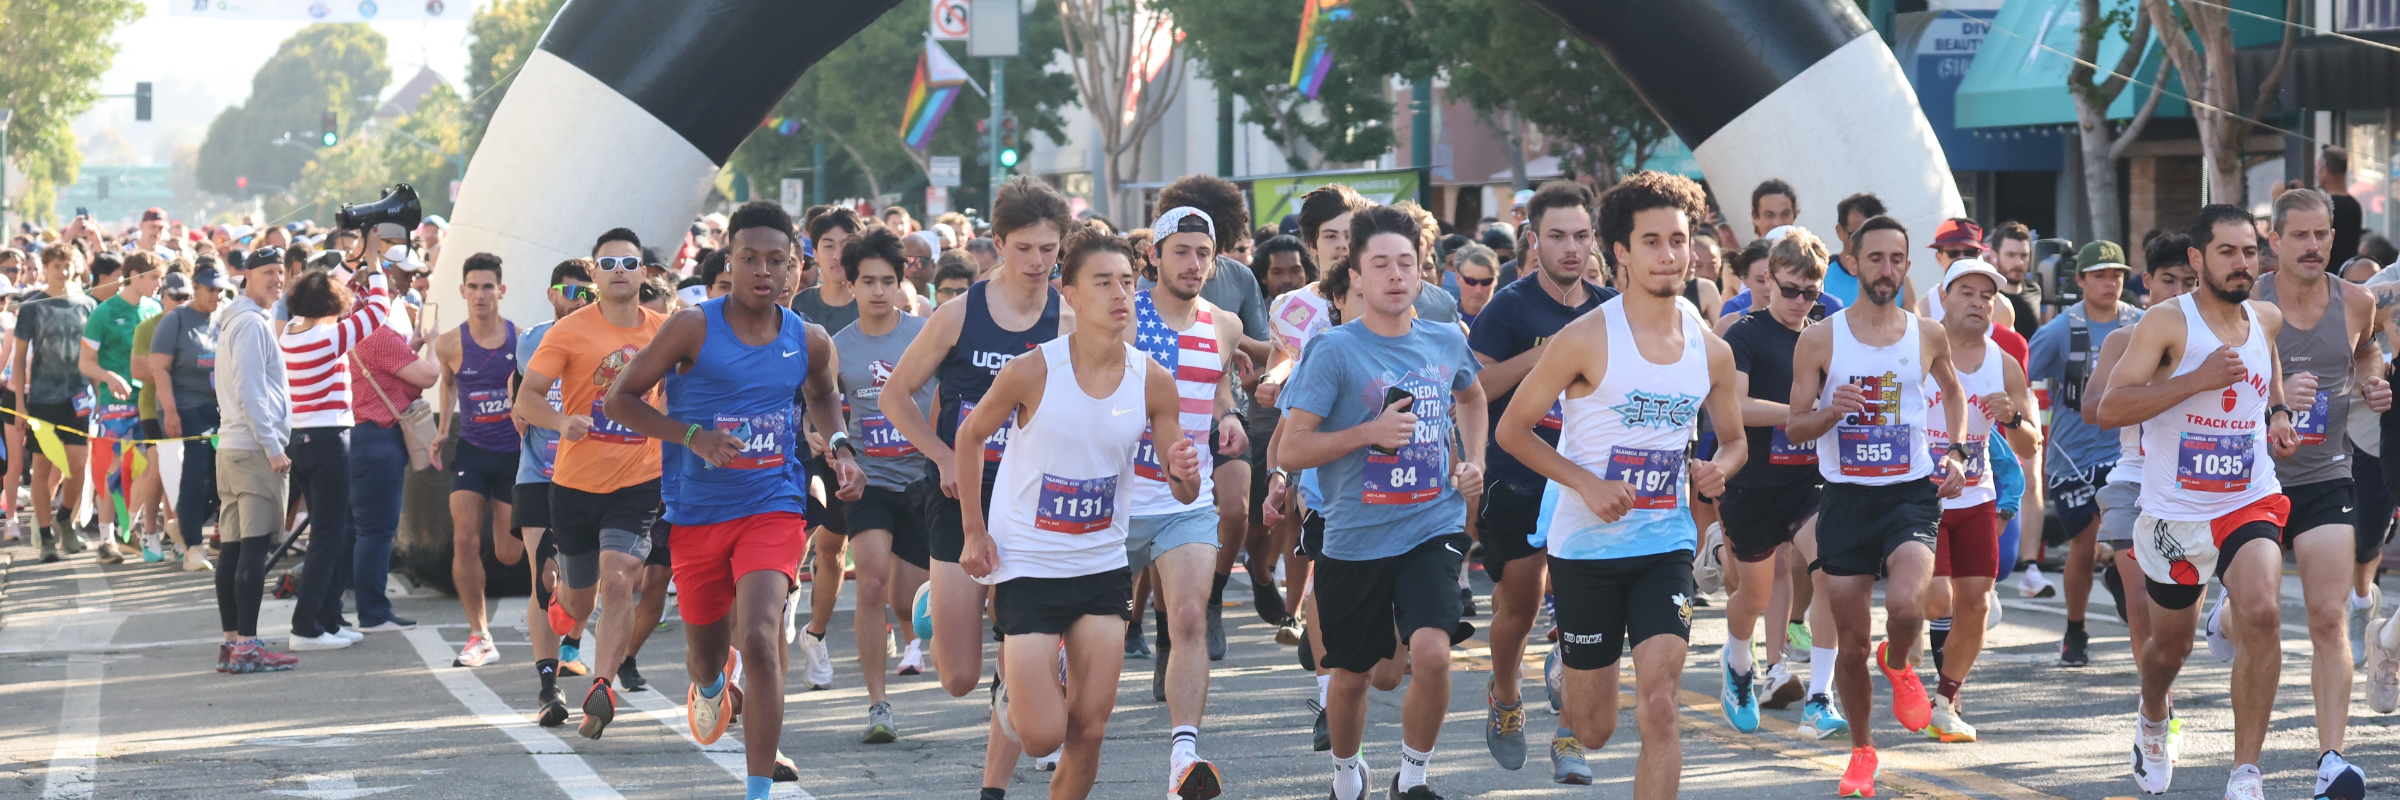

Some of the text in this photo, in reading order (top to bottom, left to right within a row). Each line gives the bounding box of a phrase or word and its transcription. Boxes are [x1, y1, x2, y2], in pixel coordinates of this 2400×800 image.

[1411, 384, 1439, 399] MEDA
[478, 398, 511, 414] 1224
[1416, 399, 1440, 418] 4TH
[2186, 413, 2257, 430] TRACK CLUB
[1927, 429, 1949, 438] TRA
[1615, 448, 1638, 456] ALAMEDA
[1856, 442, 1893, 462] 555
[2192, 453, 2244, 476] 1035
[1390, 465, 1418, 488] 84
[1620, 468, 1671, 492] 1197
[1053, 495, 1103, 518] 1131
